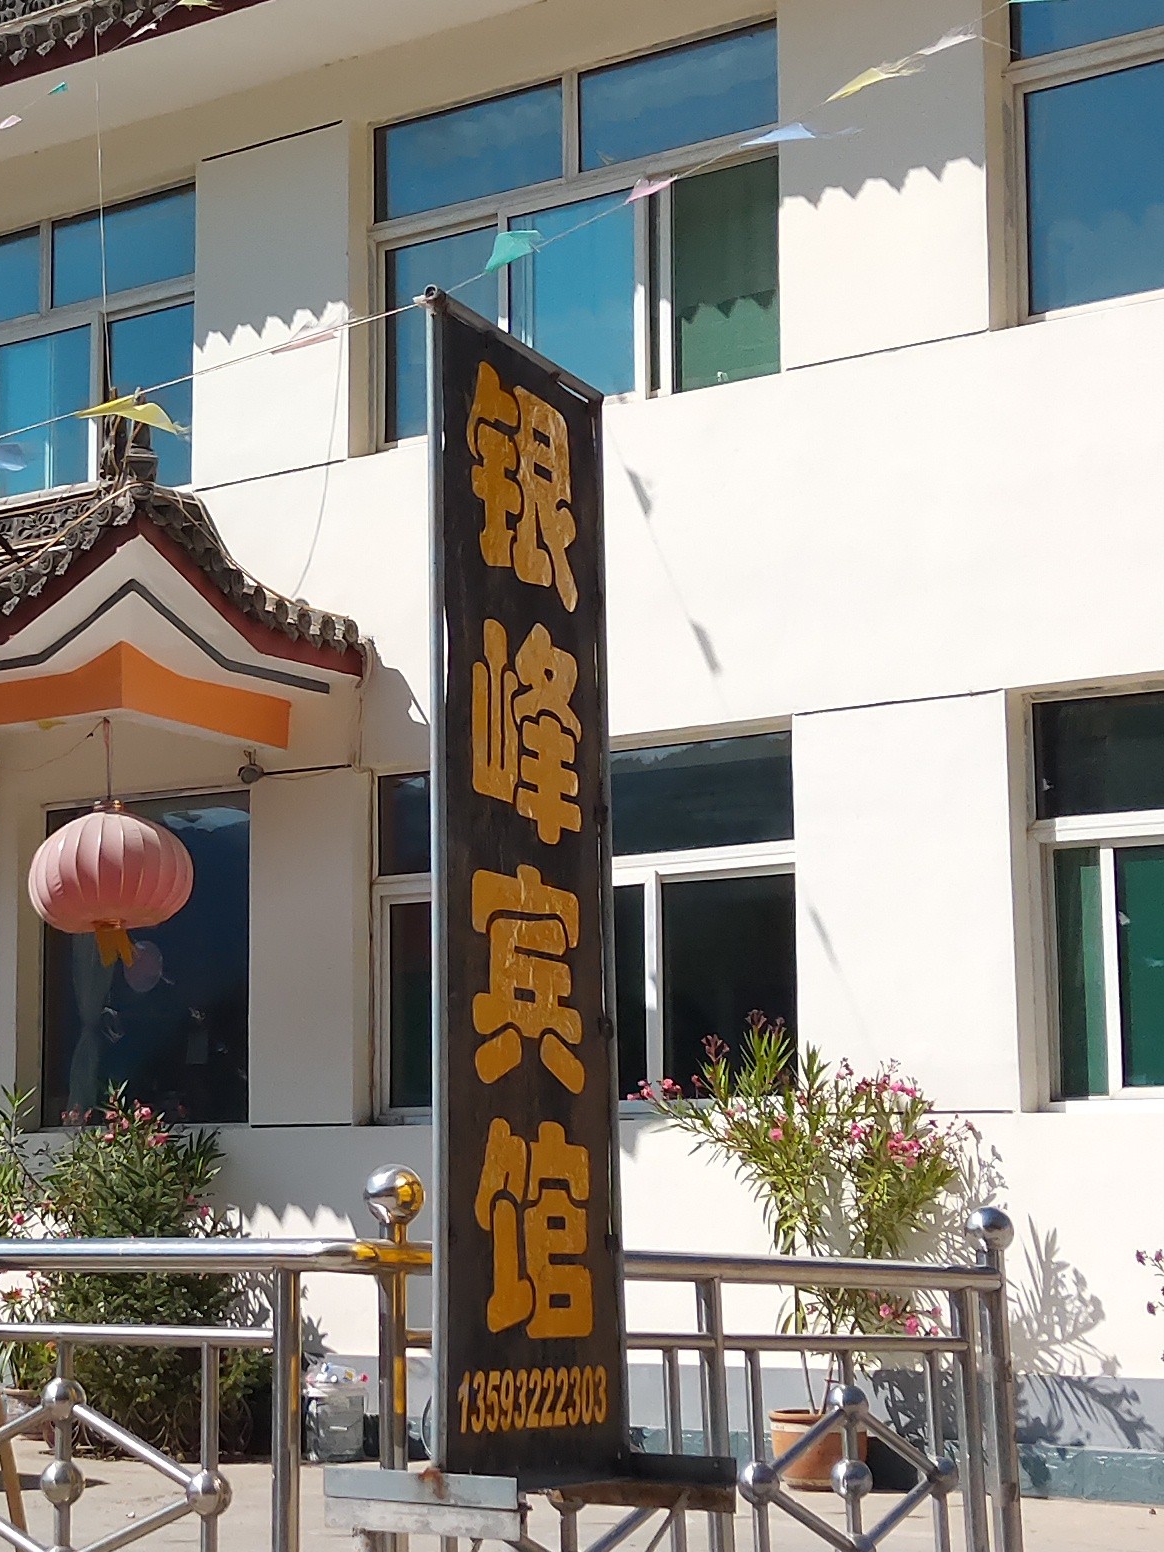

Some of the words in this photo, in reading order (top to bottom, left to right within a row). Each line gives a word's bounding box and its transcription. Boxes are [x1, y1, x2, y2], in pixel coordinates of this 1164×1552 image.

[467, 360, 596, 1341] 银峰宾馆
[457, 1365, 607, 1434] 13593222303
